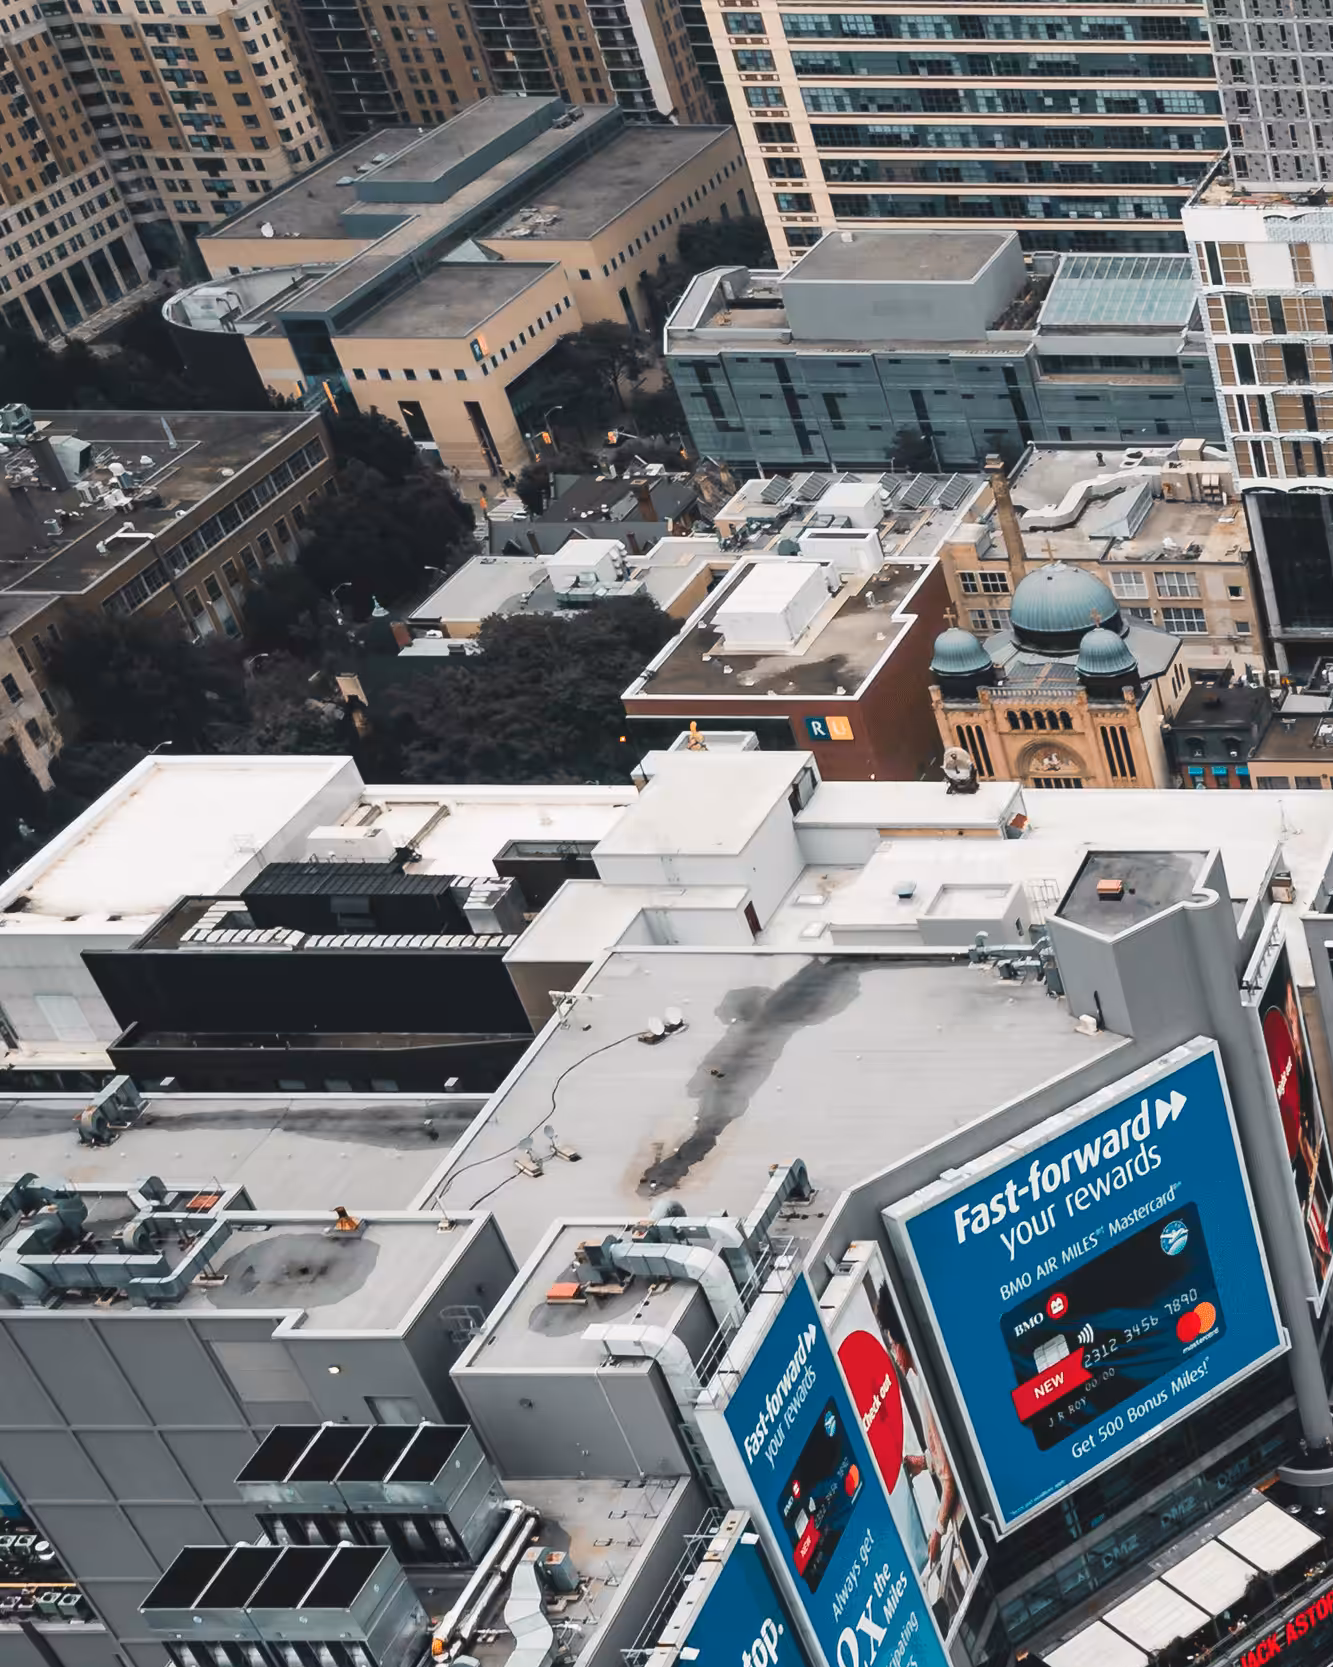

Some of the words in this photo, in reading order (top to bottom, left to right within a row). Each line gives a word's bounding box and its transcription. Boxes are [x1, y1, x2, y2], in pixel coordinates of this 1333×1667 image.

[954, 1098, 1149, 1245] Fast-forward
[1000, 1213, 1056, 1261] your
[1065, 1142, 1163, 1216] rewards
[999, 1271, 1031, 1301] BMO
[1036, 1258, 1058, 1281] AIR
[1014, 1312, 1044, 1337] BMO
[744, 1333, 807, 1464] Fast-forward
[764, 1423, 785, 1470] your
[783, 1365, 817, 1430] rewards
[1033, 1372, 1065, 1399] NEW
[1071, 1434, 1096, 1458] Get
[1098, 1415, 1124, 1442] 500
[1127, 1389, 1168, 1422] Bonus
[832, 1557, 860, 1623] Always
[859, 1527, 874, 1566] get
[873, 1562, 892, 1598] the
[883, 1570, 908, 1624] Miles
